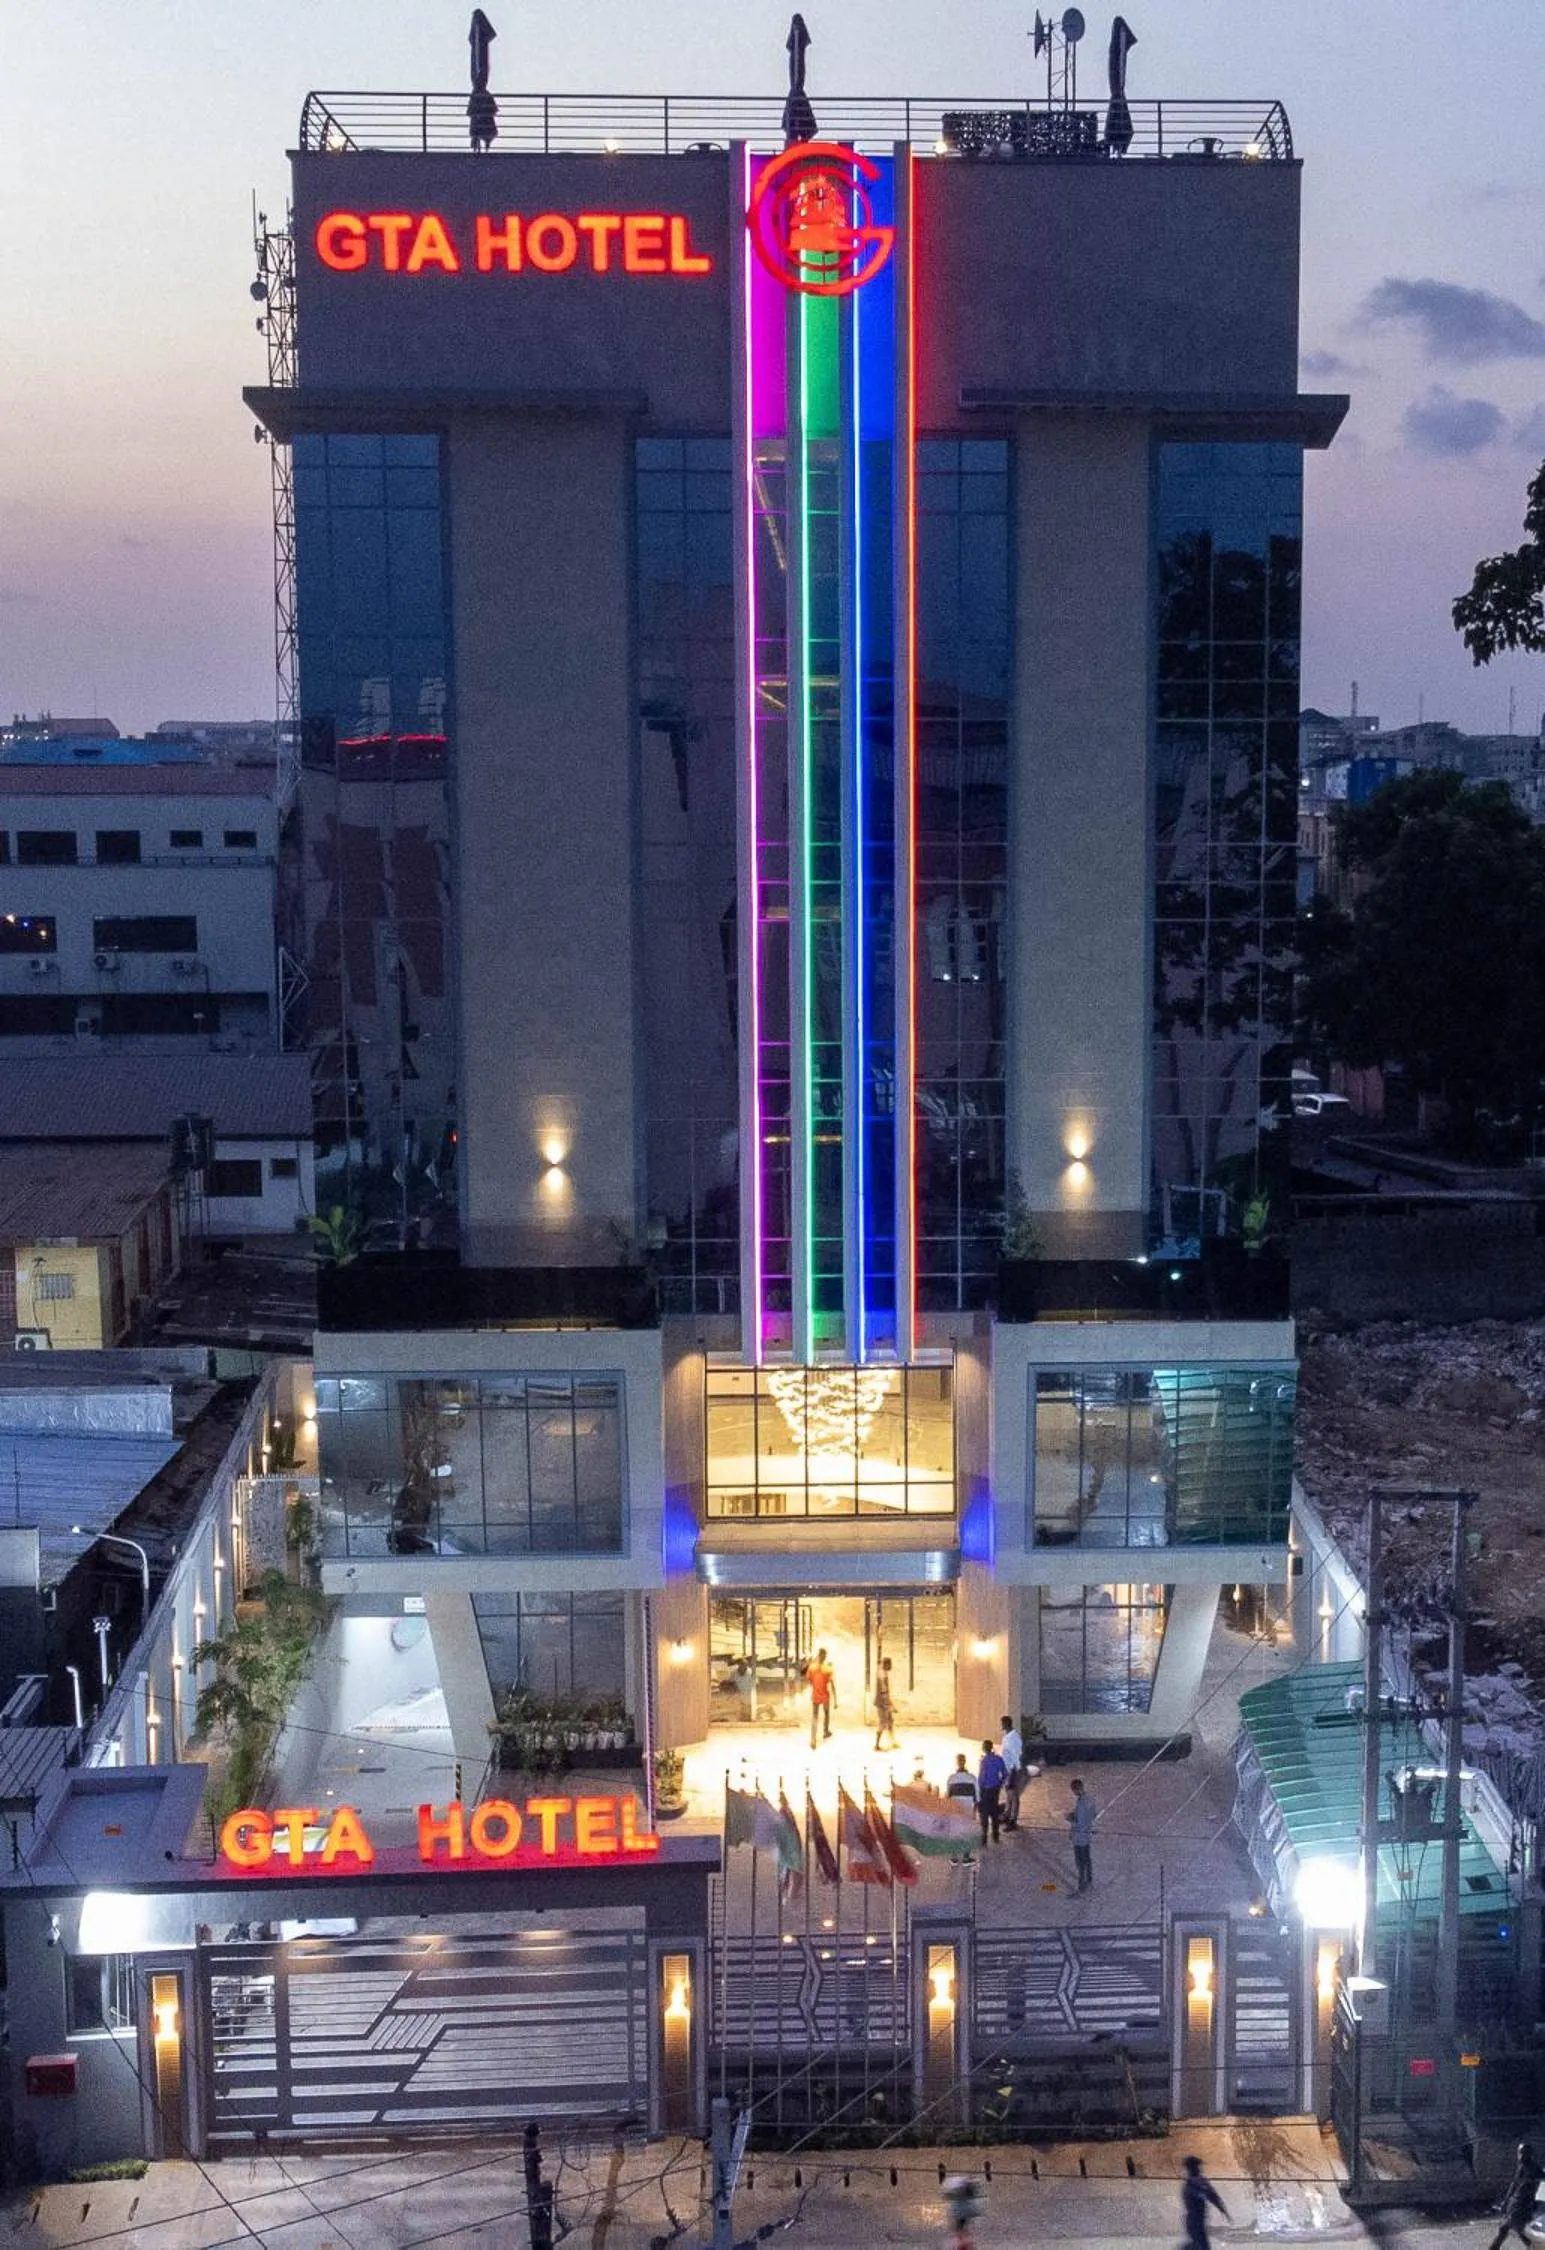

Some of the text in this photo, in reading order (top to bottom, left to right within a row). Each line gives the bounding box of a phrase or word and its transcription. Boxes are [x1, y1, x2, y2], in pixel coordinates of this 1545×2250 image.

[316, 213, 711, 274] GTA HOTEL
[220, 1795, 660, 1868] GTA HOTEL
